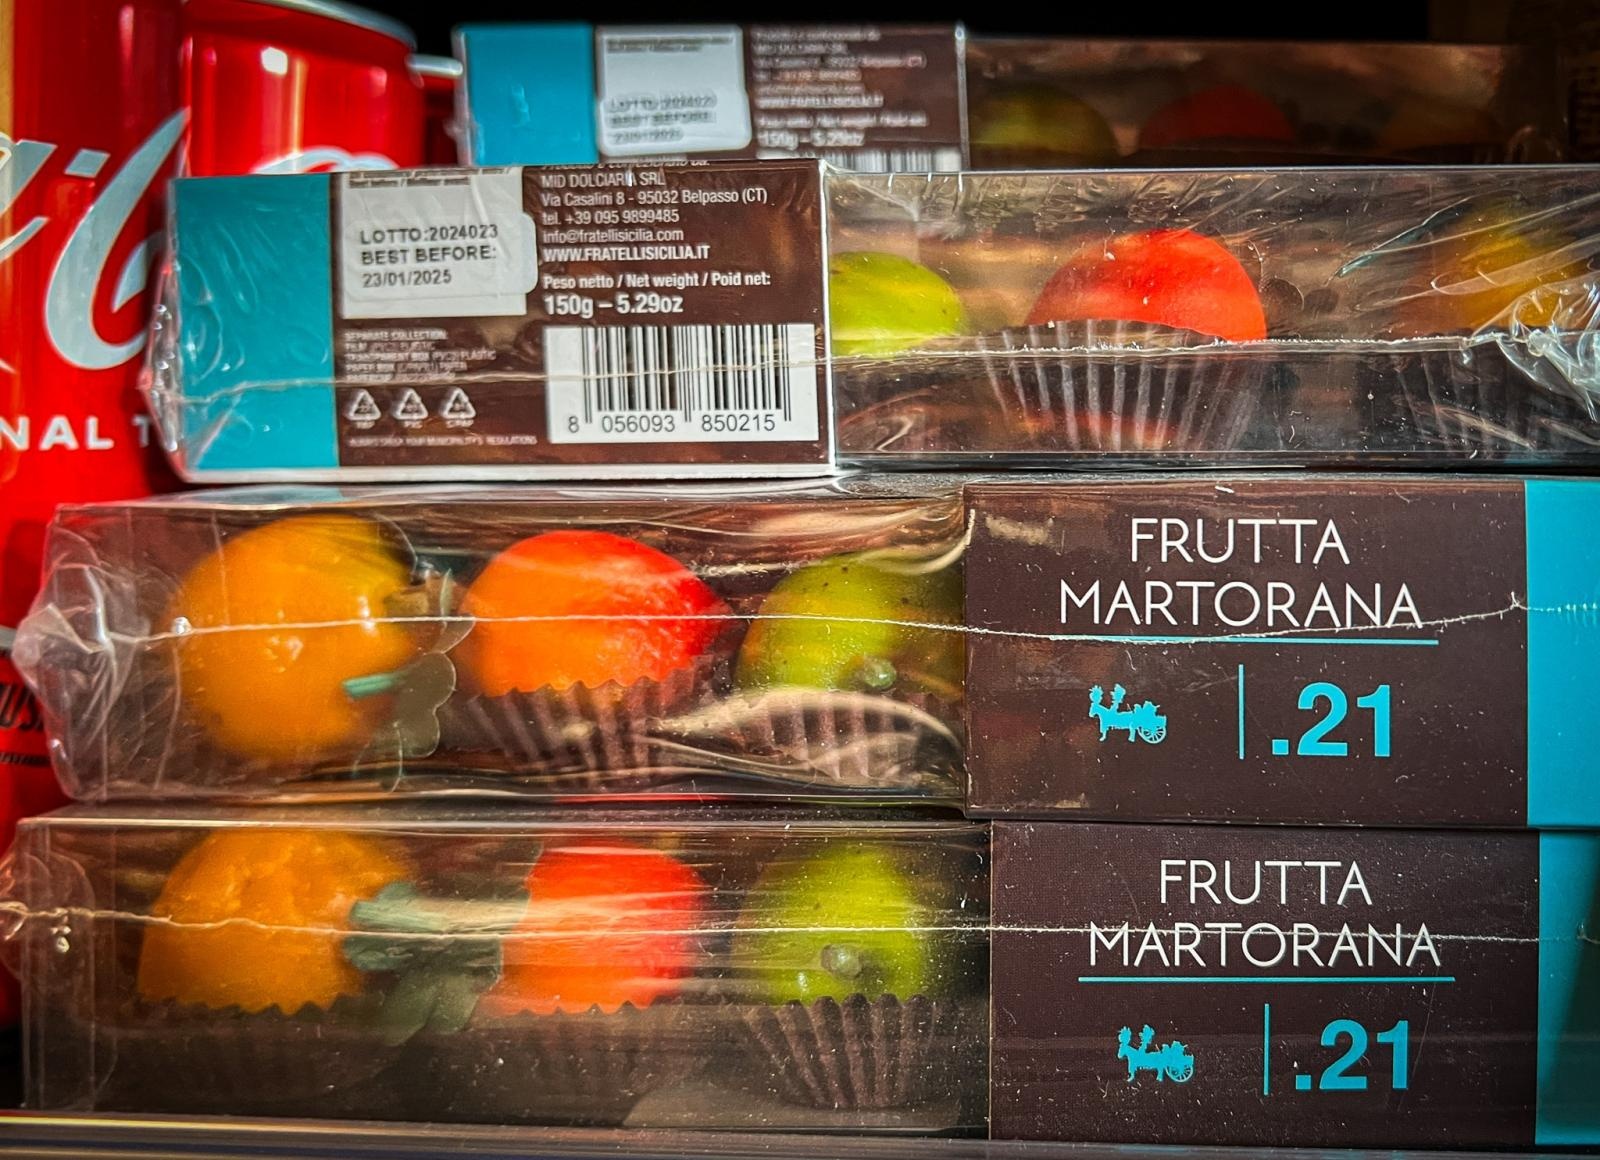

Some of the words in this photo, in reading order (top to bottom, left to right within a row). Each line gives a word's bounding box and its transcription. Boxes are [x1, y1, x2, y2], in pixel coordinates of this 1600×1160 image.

[541, 174, 566, 188] MID
[640, 171, 666, 186] SRL
[542, 194, 561, 206] Via
[564, 191, 613, 206] Casalini
[616, 191, 625, 205] 8
[638, 189, 678, 204] 95032
[682, 187, 739, 205] Belpasso
[742, 187, 768, 204] (CT)
[542, 212, 561, 225] tel.
[565, 210, 591, 224] +39
[594, 210, 620, 224] 095
[622, 209, 680, 223] 9899485
[542, 227, 684, 243] info@fratellisicilia.com
[362, 250, 408, 265] BEST
[415, 245, 497, 262] BEFORE:
[542, 245, 711, 262] WWW.FRATELLISICILIA.IT
[363, 269, 453, 288] 23/01/2025
[543, 275, 576, 290] Peso
[579, 274, 614, 289] netto
[626, 273, 650, 288] Net
[653, 272, 699, 290] weight
[711, 271, 742, 286] Poid
[745, 271, 771, 286] net:
[544, 295, 594, 319] 150g
[617, 292, 684, 315] 5.29oz
[567, 416, 580, 433] 8
[601, 415, 676, 433] 056093
[701, 414, 776, 432] 850215
[1131, 518, 1350, 564] FRUTTA
[1059, 578, 1423, 629] MARTORANA
[1271, 681, 1391, 757] .21
[1160, 859, 1372, 906] FRUTTA
[1089, 920, 1441, 968] MARTORANA
[1295, 1018, 1409, 1091] .21
